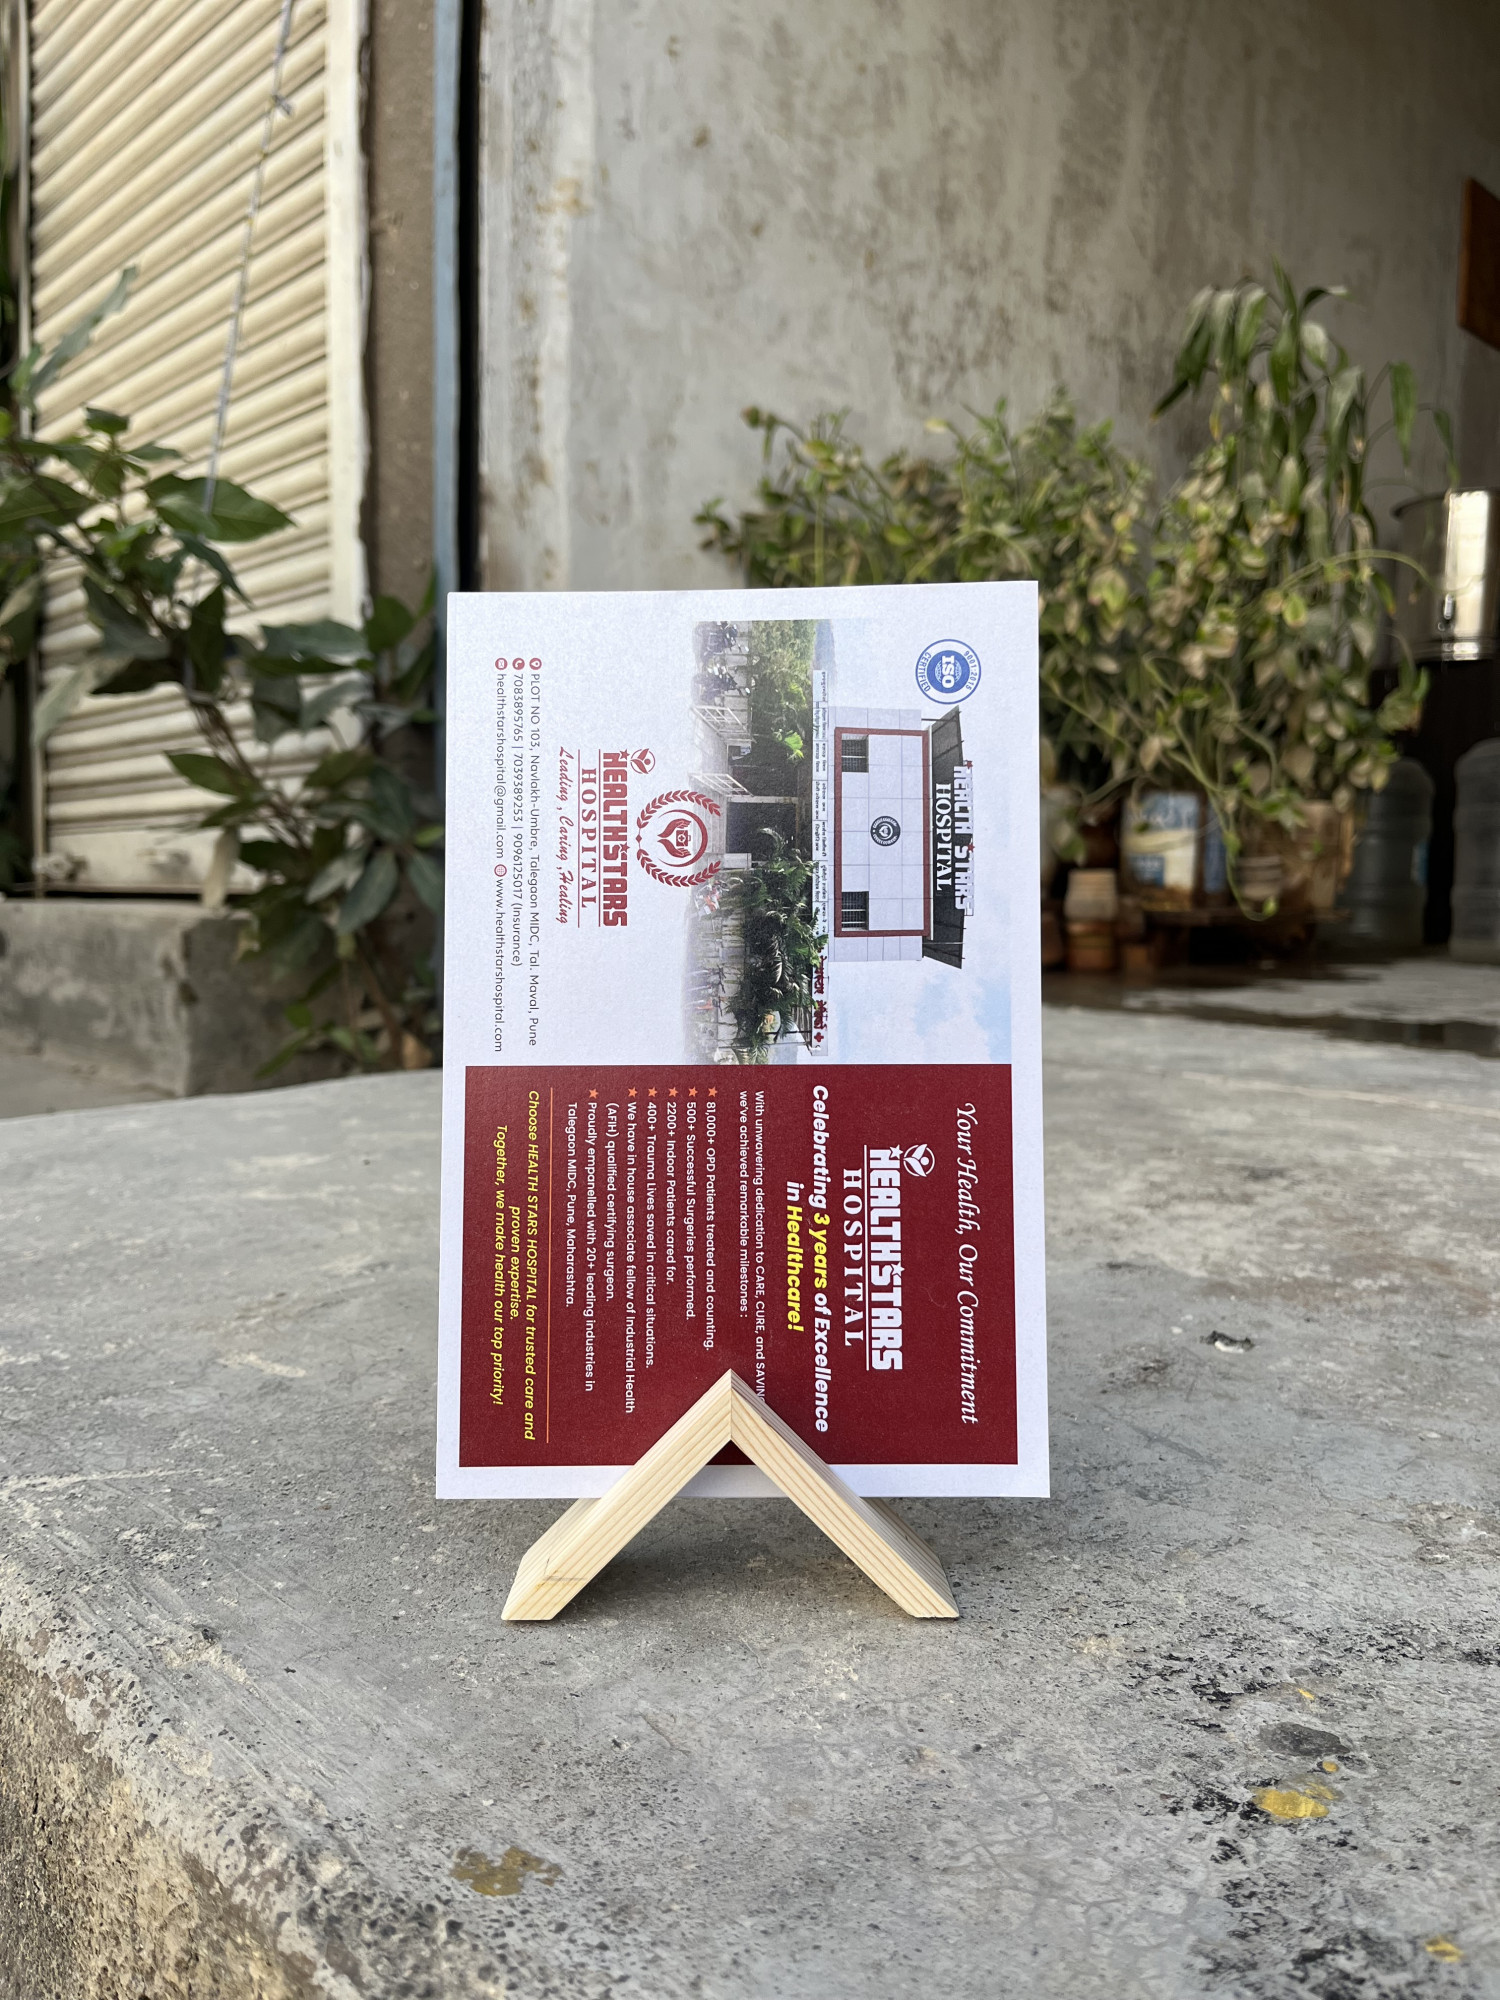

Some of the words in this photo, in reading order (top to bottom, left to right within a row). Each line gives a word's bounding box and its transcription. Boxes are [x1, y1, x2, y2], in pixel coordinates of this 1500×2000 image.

[530, 674, 540, 702] PLOT
[918, 652, 931, 692] CERTIFIED
[942, 656, 955, 688] ISO
[964, 650, 977, 690] 9001:2015
[513, 674, 523, 742] 7083895765
[530, 706, 540, 725] NO
[529, 728, 540, 751] 103,
[493, 674, 507, 859] healthstarshospital@gmail.com
[513, 753, 523, 822] 7039389253
[529, 755, 540, 850] Navlakh-Umbre,
[555, 816, 574, 861] Caring
[581, 768, 597, 908] HOSPITAL
[513, 833, 523, 899] 9096125017
[527, 854, 540, 908] Talegaon
[510, 903, 523, 966] (Insurance)
[528, 912, 539, 946] MIDC,
[493, 879, 506, 1052] www.healthstarshospital.com
[530, 950, 540, 970] Tal.
[528, 975, 539, 1013] Maval,
[529, 1018, 539, 1046] Pune
[528, 1091, 540, 1141] Choose
[585, 1102, 597, 1145] Proudly
[605, 1103, 619, 1137] (AFIH)
[627, 1102, 637, 1120] We
[647, 1102, 657, 1131] 400+
[667, 1102, 677, 1137] 2200+
[687, 1102, 696, 1131] 500+
[705, 1102, 716, 1144] 81,000+
[755, 1091, 765, 1116] With
[565, 1102, 578, 1156] Talegaon
[627, 1123, 637, 1152] have
[808, 1085, 831, 1209] Celebrating
[957, 1103, 978, 1155] Your
[493, 1125, 507, 1185] Together,
[528, 1144, 539, 1192] HEALTH
[605, 1140, 617, 1191] qualified
[627, 1155, 637, 1165] in
[647, 1134, 656, 1180] Trauma
[667, 1140, 676, 1177] Indoor
[686, 1134, 696, 1195] Successful
[706, 1148, 715, 1172] OPD
[740, 1125, 750, 1177] achieved
[753, 1119, 765, 1185] unwavering
[566, 1159, 577, 1192] MIDC,
[584, 1148, 597, 1217] empanelled
[627, 1168, 637, 1203] house
[647, 1183, 657, 1210] Lives
[787, 1181, 804, 1201] in
[955, 1157, 980, 1234] Health,
[496, 1190, 505, 1209] we
[527, 1195, 538, 1235] STARS
[566, 1195, 576, 1226] Pune,
[666, 1180, 676, 1227] Patients
[706, 1175, 716, 1221] Patients
[740, 1180, 749, 1246] remarkable
[755, 1188, 765, 1249] dedication
[814, 1213, 830, 1225] 3
[495, 1212, 506, 1250] make
[508, 1206, 520, 1253] proven
[587, 1220, 597, 1244] with
[604, 1194, 617, 1248] certifying
[626, 1206, 636, 1262] associate
[646, 1213, 656, 1248] saved
[683, 1198, 696, 1252] Surgeries
[587, 1247, 596, 1269] 20+
[647, 1252, 656, 1262] in
[666, 1229, 676, 1263] cared
[706, 1224, 716, 1266] treated
[756, 1251, 764, 1263] to
[809, 1228, 827, 1288] years
[843, 1168, 863, 1346] HOSPITAL
[959, 1244, 978, 1287] Our
[495, 1254, 506, 1296] health
[507, 1256, 521, 1320] expertise.
[526, 1239, 537, 1300] HOSPITAL
[566, 1229, 576, 1307] Maharashtra.
[603, 1251, 614, 1302] surgeon.
[626, 1265, 636, 1299] fellow
[646, 1265, 656, 1305] critical
[666, 1266, 676, 1285] for.
[684, 1255, 696, 1320] performed.
[706, 1269, 716, 1292] and
[740, 1249, 750, 1312] milestones
[754, 1266, 765, 1298] CARE,
[787, 1205, 804, 1332] Healthcare!
[494, 1300, 503, 1323] our
[526, 1304, 537, 1323] for
[583, 1273, 596, 1317] leading
[626, 1302, 636, 1313] of
[814, 1293, 832, 1315] of
[491, 1327, 504, 1349] top
[646, 1308, 656, 1368] situations.
[703, 1295, 716, 1351] counting.
[754, 1301, 765, 1334] CURE,
[525, 1326, 536, 1375] trusted
[585, 1320, 596, 1378] industries
[626, 1316, 636, 1371] Industrial
[756, 1336, 765, 1359] and
[957, 1291, 981, 1424] Commitment
[490, 1352, 505, 1405] priority!
[525, 1378, 534, 1409] care
[585, 1381, 595, 1391] in
[625, 1375, 635, 1413] Health
[815, 1317, 831, 1432] Excellence
[524, 1412, 535, 1440] and
